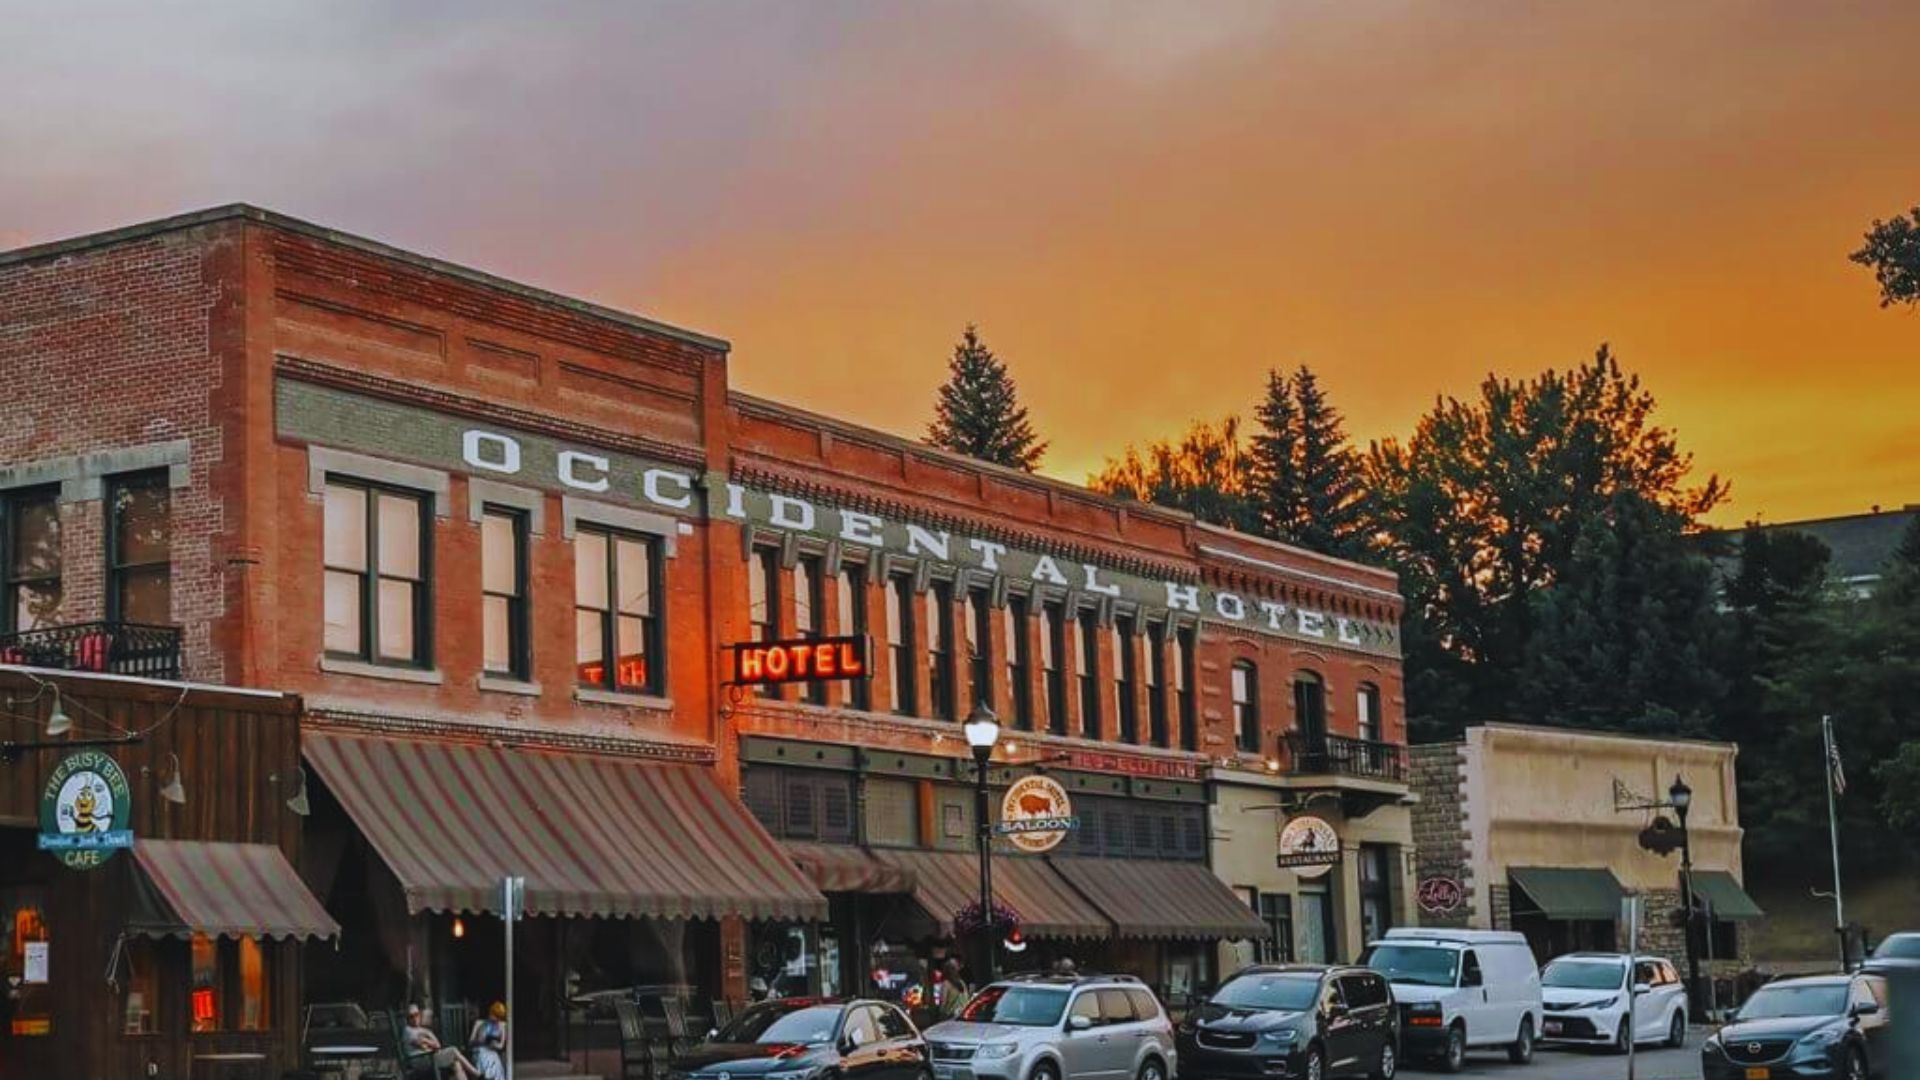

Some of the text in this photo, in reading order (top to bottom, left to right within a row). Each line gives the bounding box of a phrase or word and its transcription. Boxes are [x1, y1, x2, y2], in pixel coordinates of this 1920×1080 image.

[462, 429, 1361, 645] OCCIDENTAL HOTEL
[741, 643, 861, 678] HOTEL
[44, 752, 126, 801] THE BUSY BEE
[1001, 818, 1071, 832] SALOON
[64, 849, 101, 867] CAFE
[1280, 852, 1340, 866] RESTAURANT
